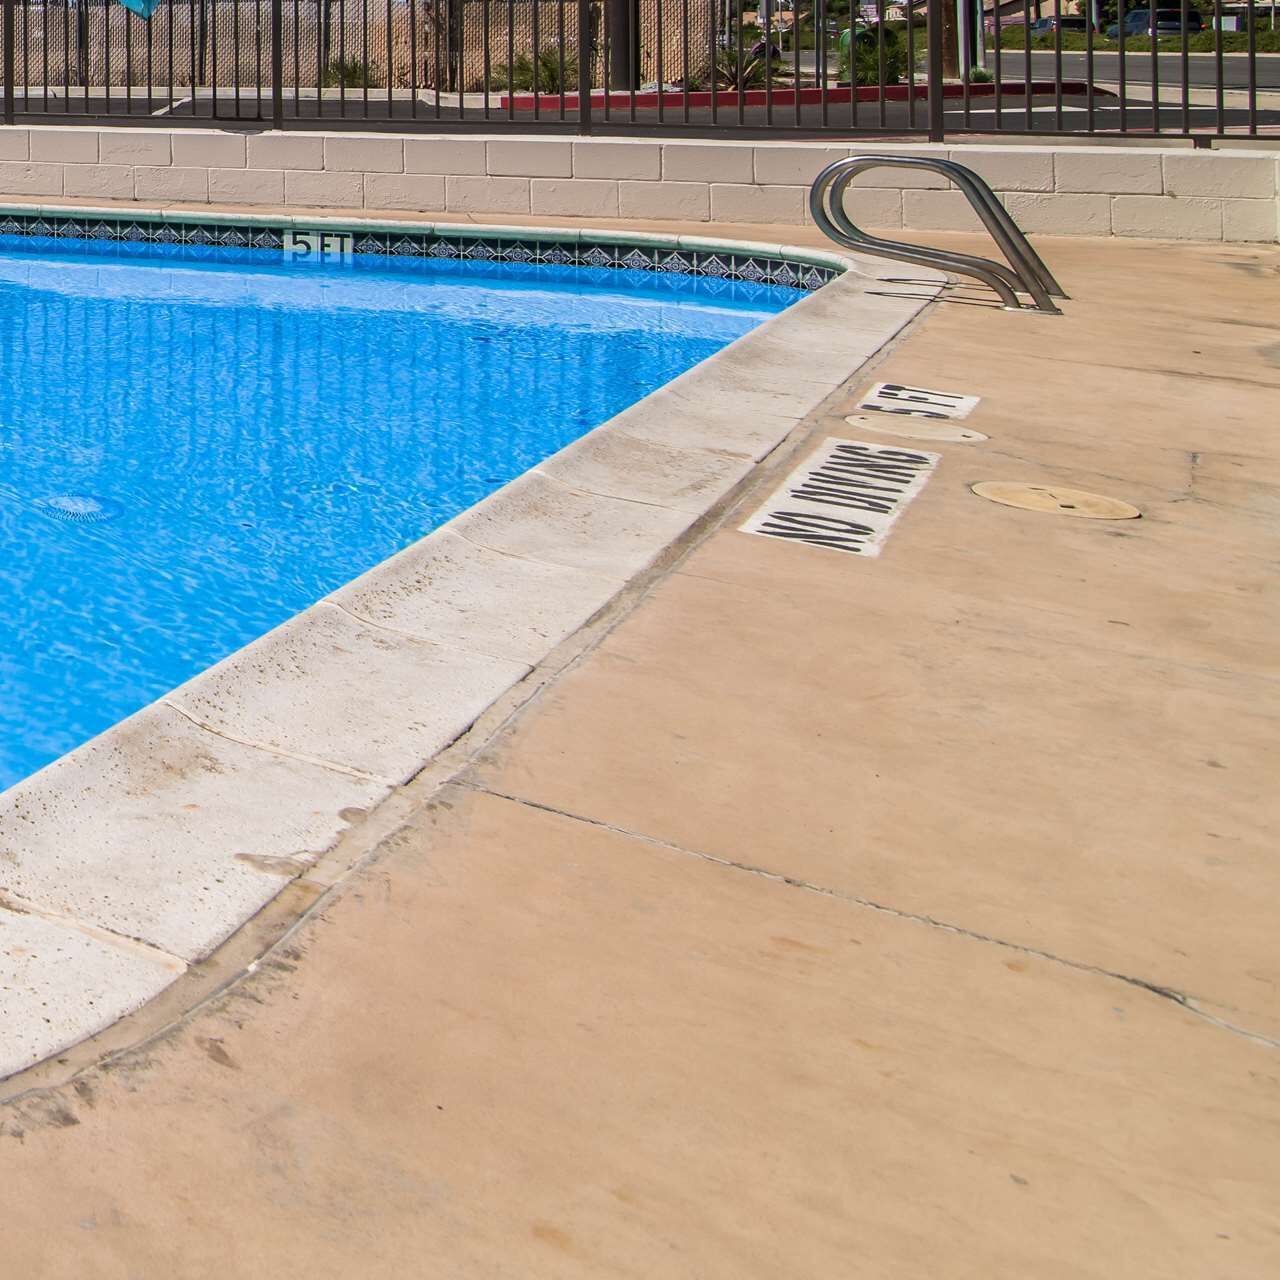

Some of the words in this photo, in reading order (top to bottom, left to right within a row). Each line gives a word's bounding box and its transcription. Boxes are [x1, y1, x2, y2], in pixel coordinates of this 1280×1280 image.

[292, 231, 311, 253] 5
[320, 232, 350, 254] FT
[877, 384, 964, 408] FT
[790, 445, 931, 514] DIVING
[756, 511, 876, 552] NO
